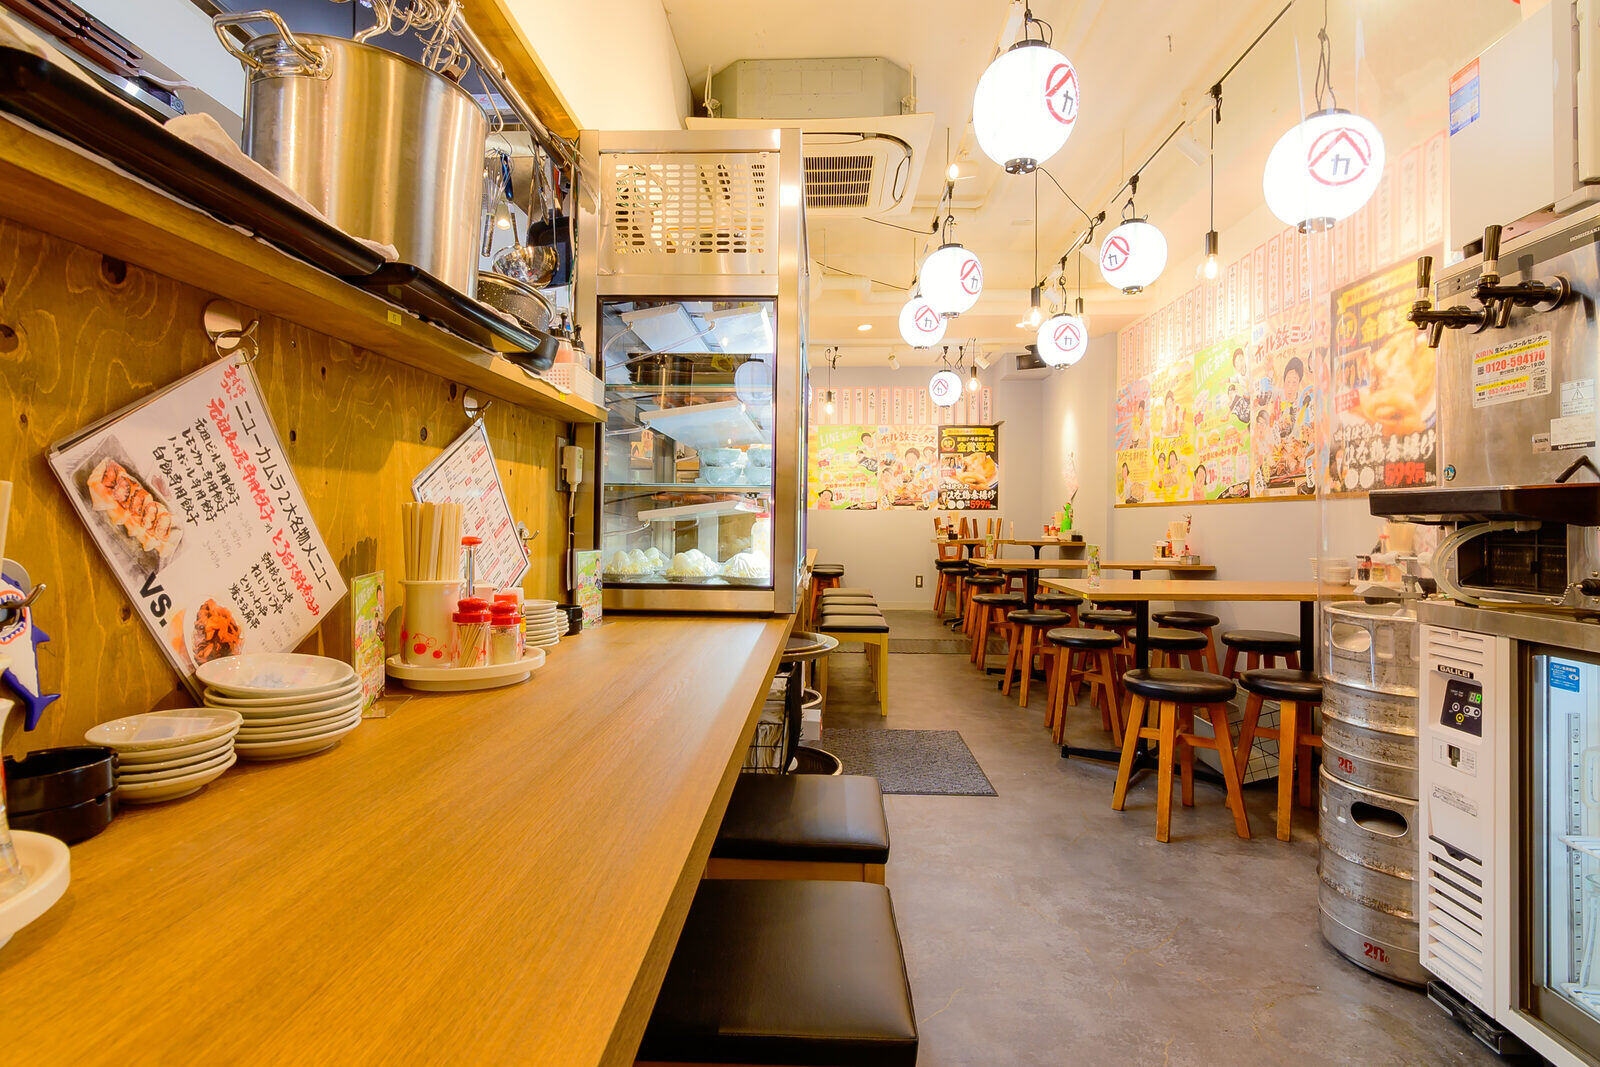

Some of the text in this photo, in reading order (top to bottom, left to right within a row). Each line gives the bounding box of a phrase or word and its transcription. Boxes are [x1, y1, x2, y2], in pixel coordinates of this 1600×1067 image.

[1485, 350, 1546, 374] 0120-594170
[139, 572, 173, 628] VS.
[1440, 665, 1471, 679] GALILEI
